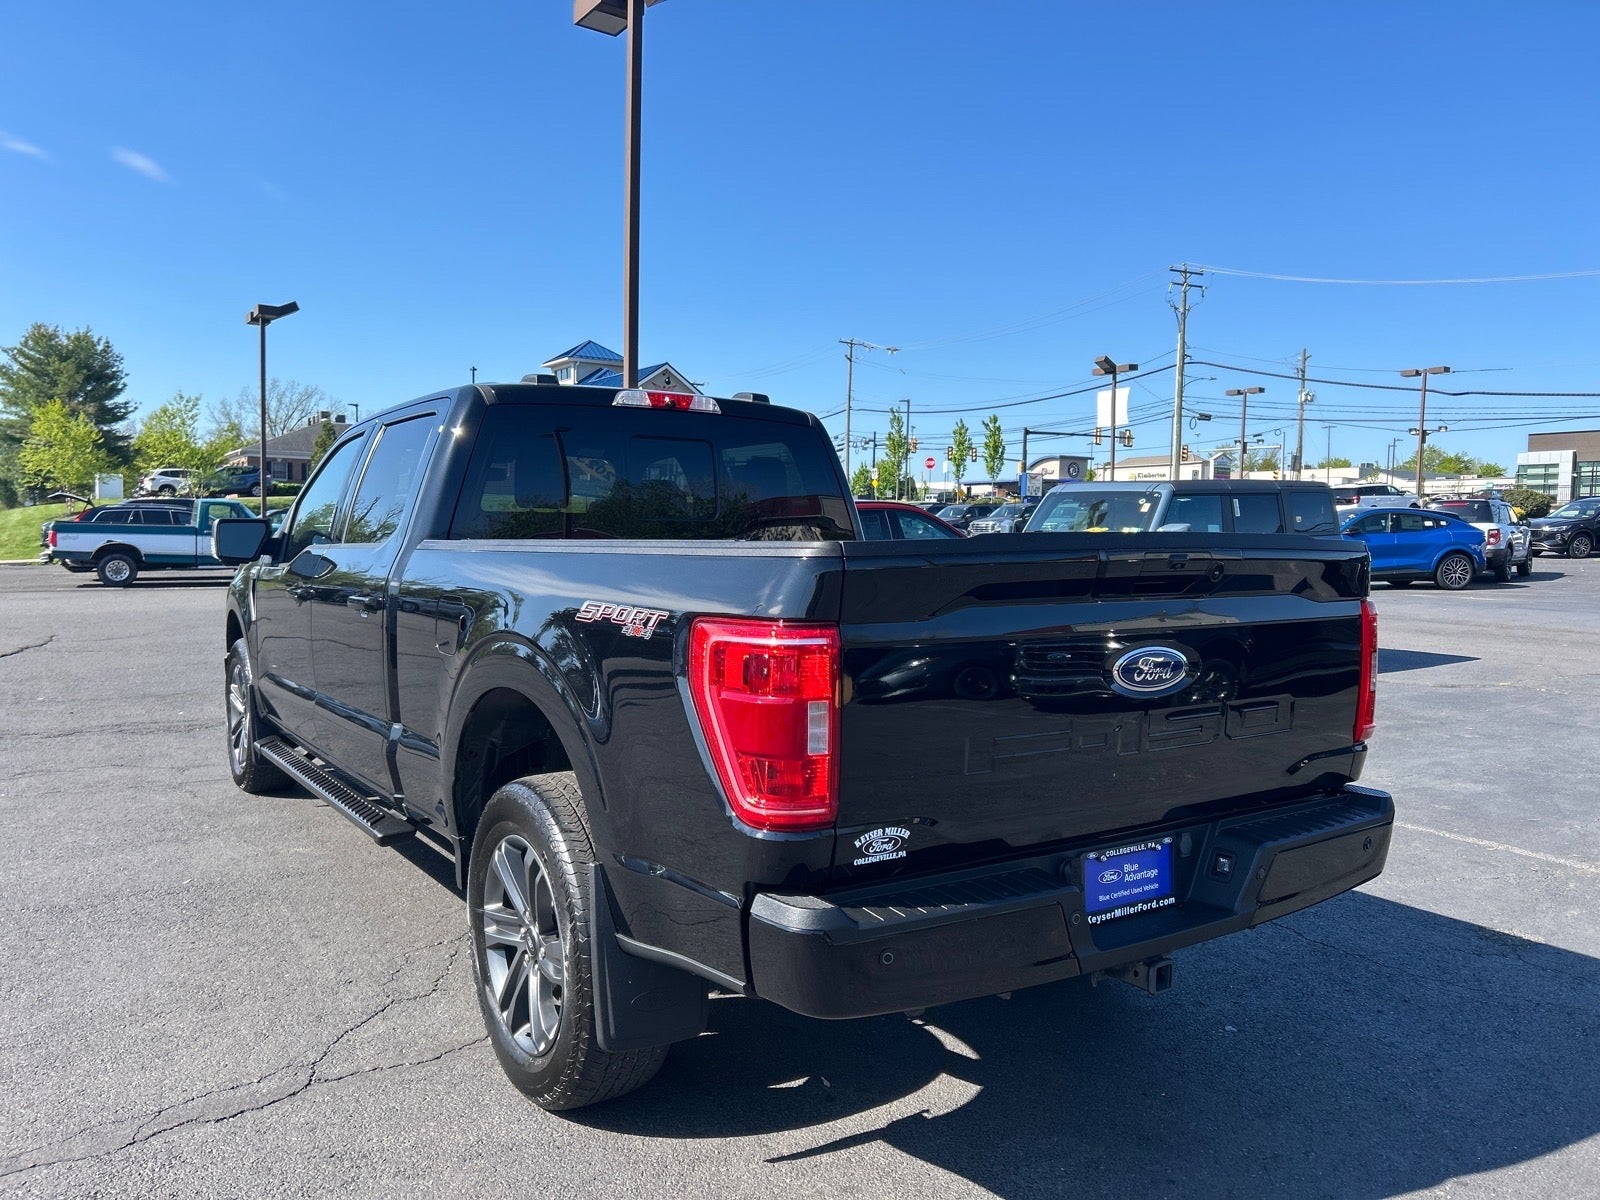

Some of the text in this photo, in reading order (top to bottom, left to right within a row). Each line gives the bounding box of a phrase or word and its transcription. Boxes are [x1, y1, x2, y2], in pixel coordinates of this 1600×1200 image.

[575, 600, 670, 631] SPORT
[1134, 657, 1175, 682] Ford
[854, 827, 911, 848] KEYSER MILLER
[868, 838, 895, 853] Ford
[1105, 844, 1147, 857] COLLEGEVILLE,
[1124, 863, 1139, 872] Blue
[1124, 868, 1159, 882] Advantage
[1103, 871, 1118, 882] Ford
[1099, 882, 1159, 902] Blue Certified Used Vehicle
